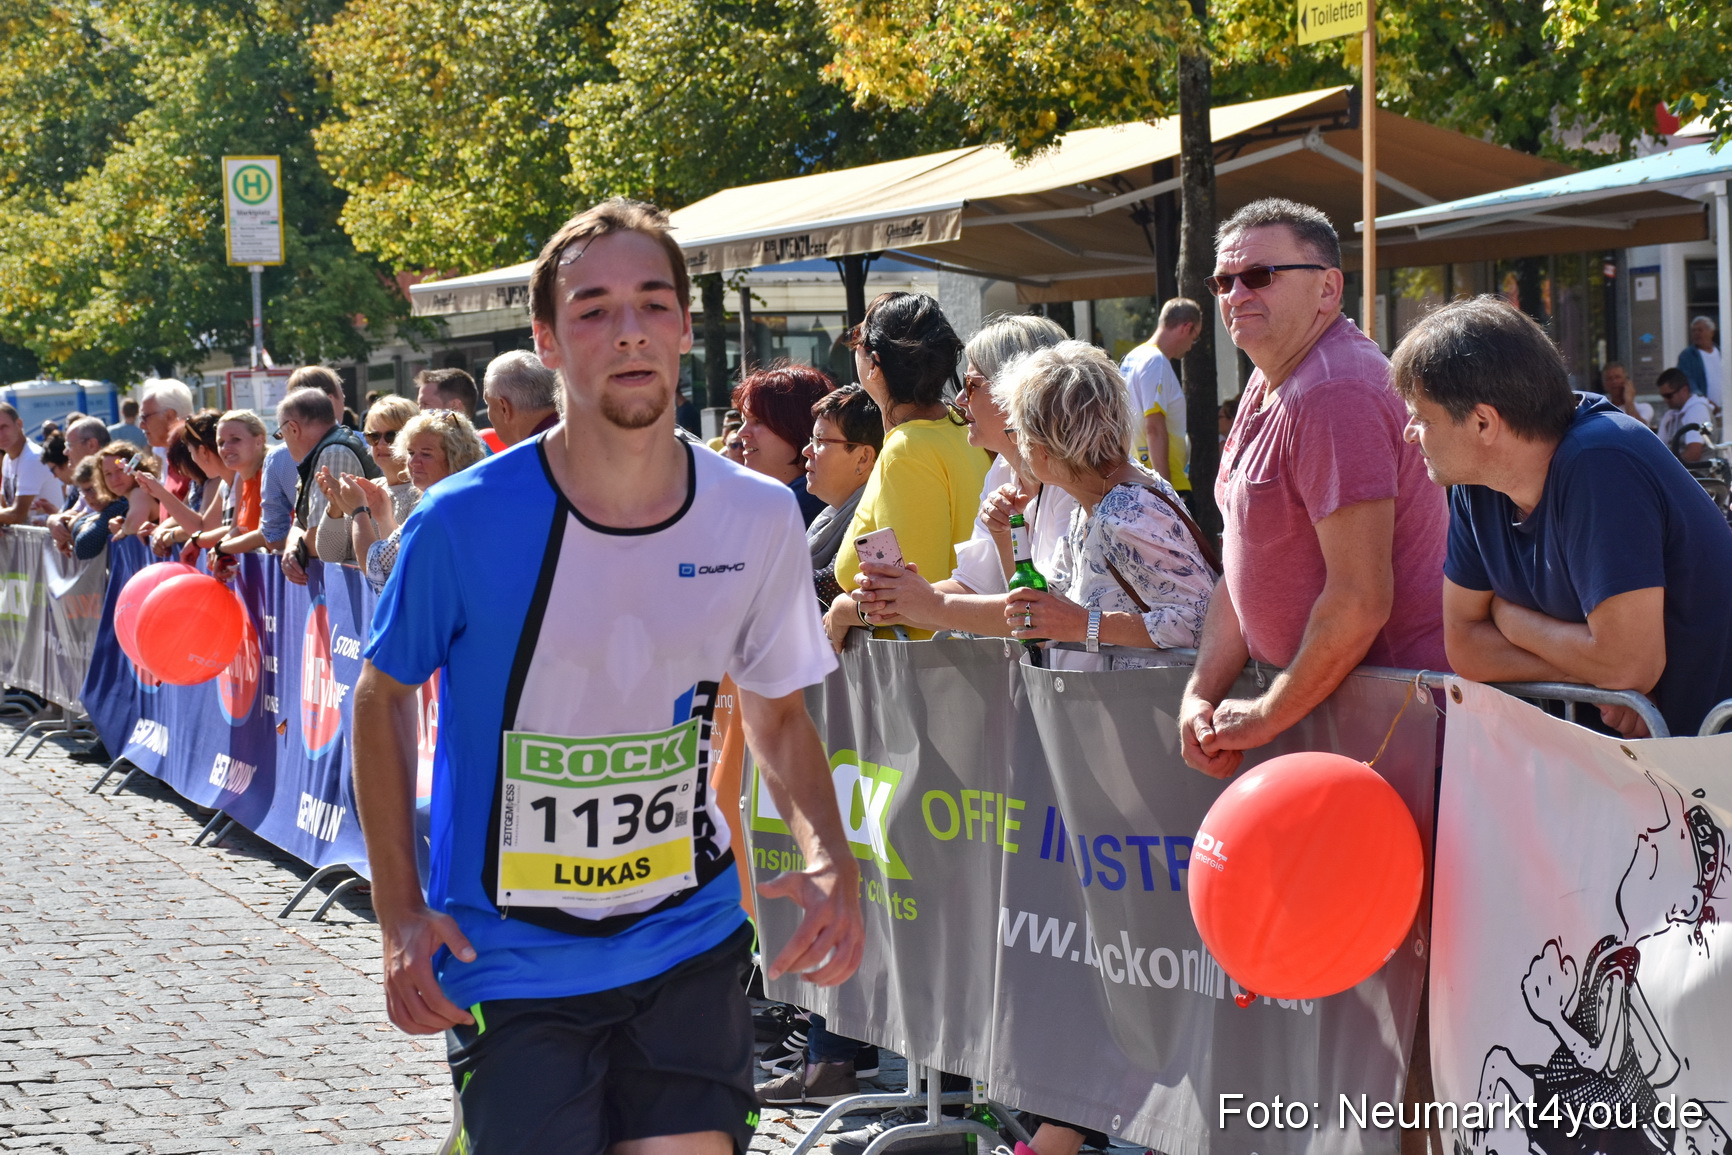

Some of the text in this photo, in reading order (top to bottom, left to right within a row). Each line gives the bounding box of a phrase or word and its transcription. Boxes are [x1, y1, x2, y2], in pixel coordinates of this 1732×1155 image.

[1311, 1, 1363, 27] Toiletten
[242, 174, 262, 196] H
[698, 562, 745, 574] owayo
[333, 635, 361, 661] STORE
[523, 731, 689, 778] BOCK
[530, 785, 679, 848] 1136
[554, 857, 652, 886] LUKAS
